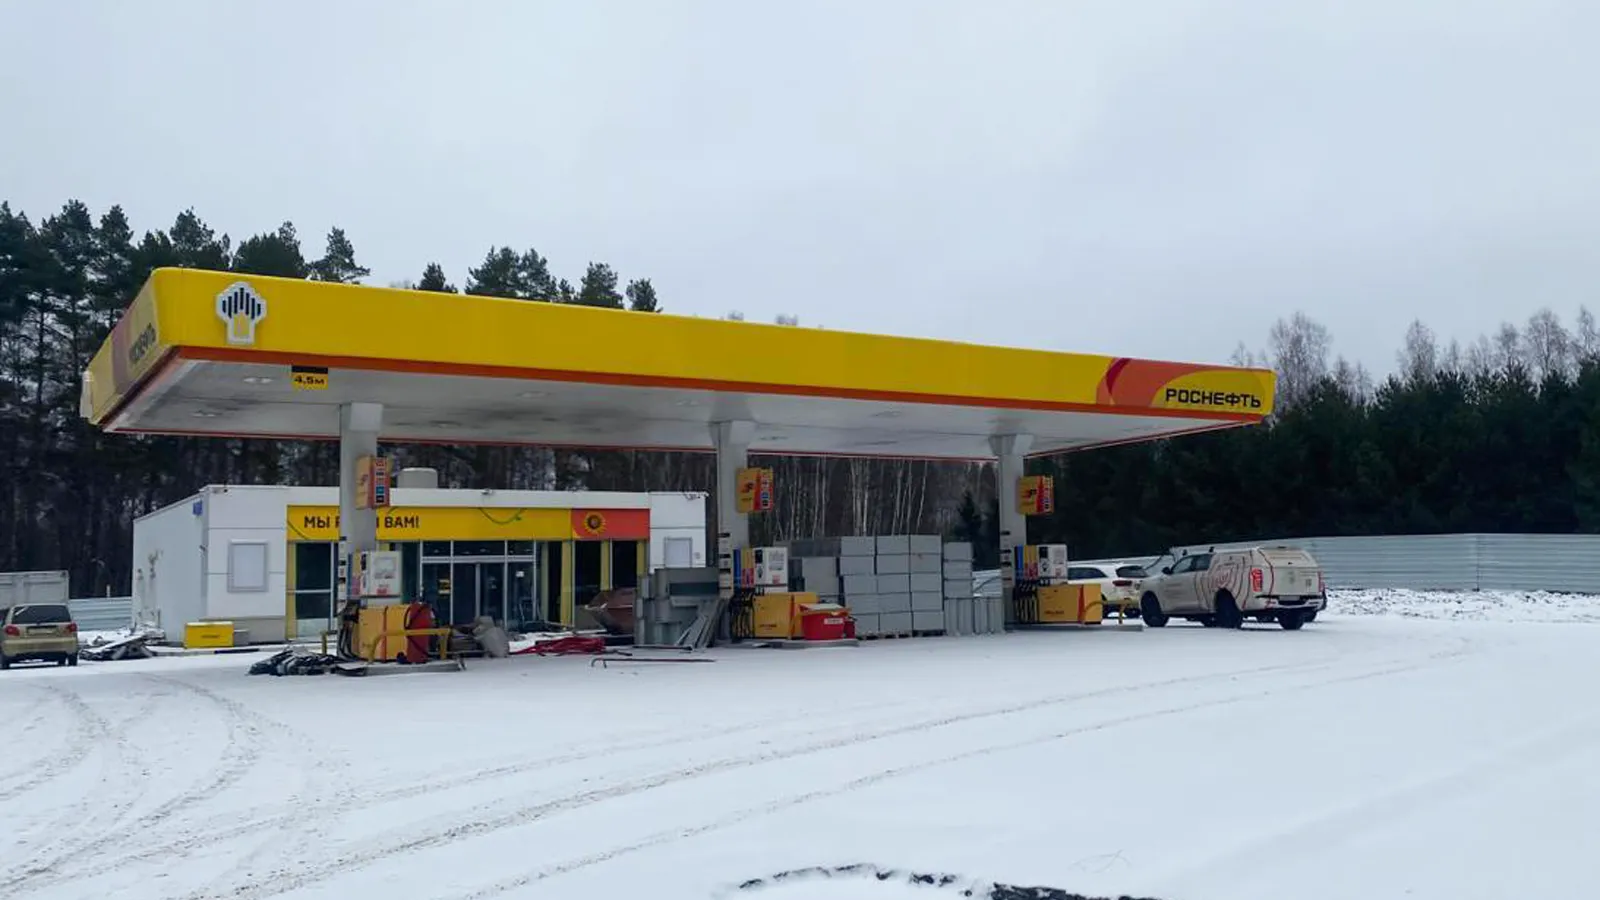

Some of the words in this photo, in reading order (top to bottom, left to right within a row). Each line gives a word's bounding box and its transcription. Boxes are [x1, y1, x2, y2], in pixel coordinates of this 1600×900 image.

[1165, 388, 1261, 408] РОСНЕФТЬ
[304, 516, 330, 528] МЫ
[384, 516, 420, 528] ВАМ!
